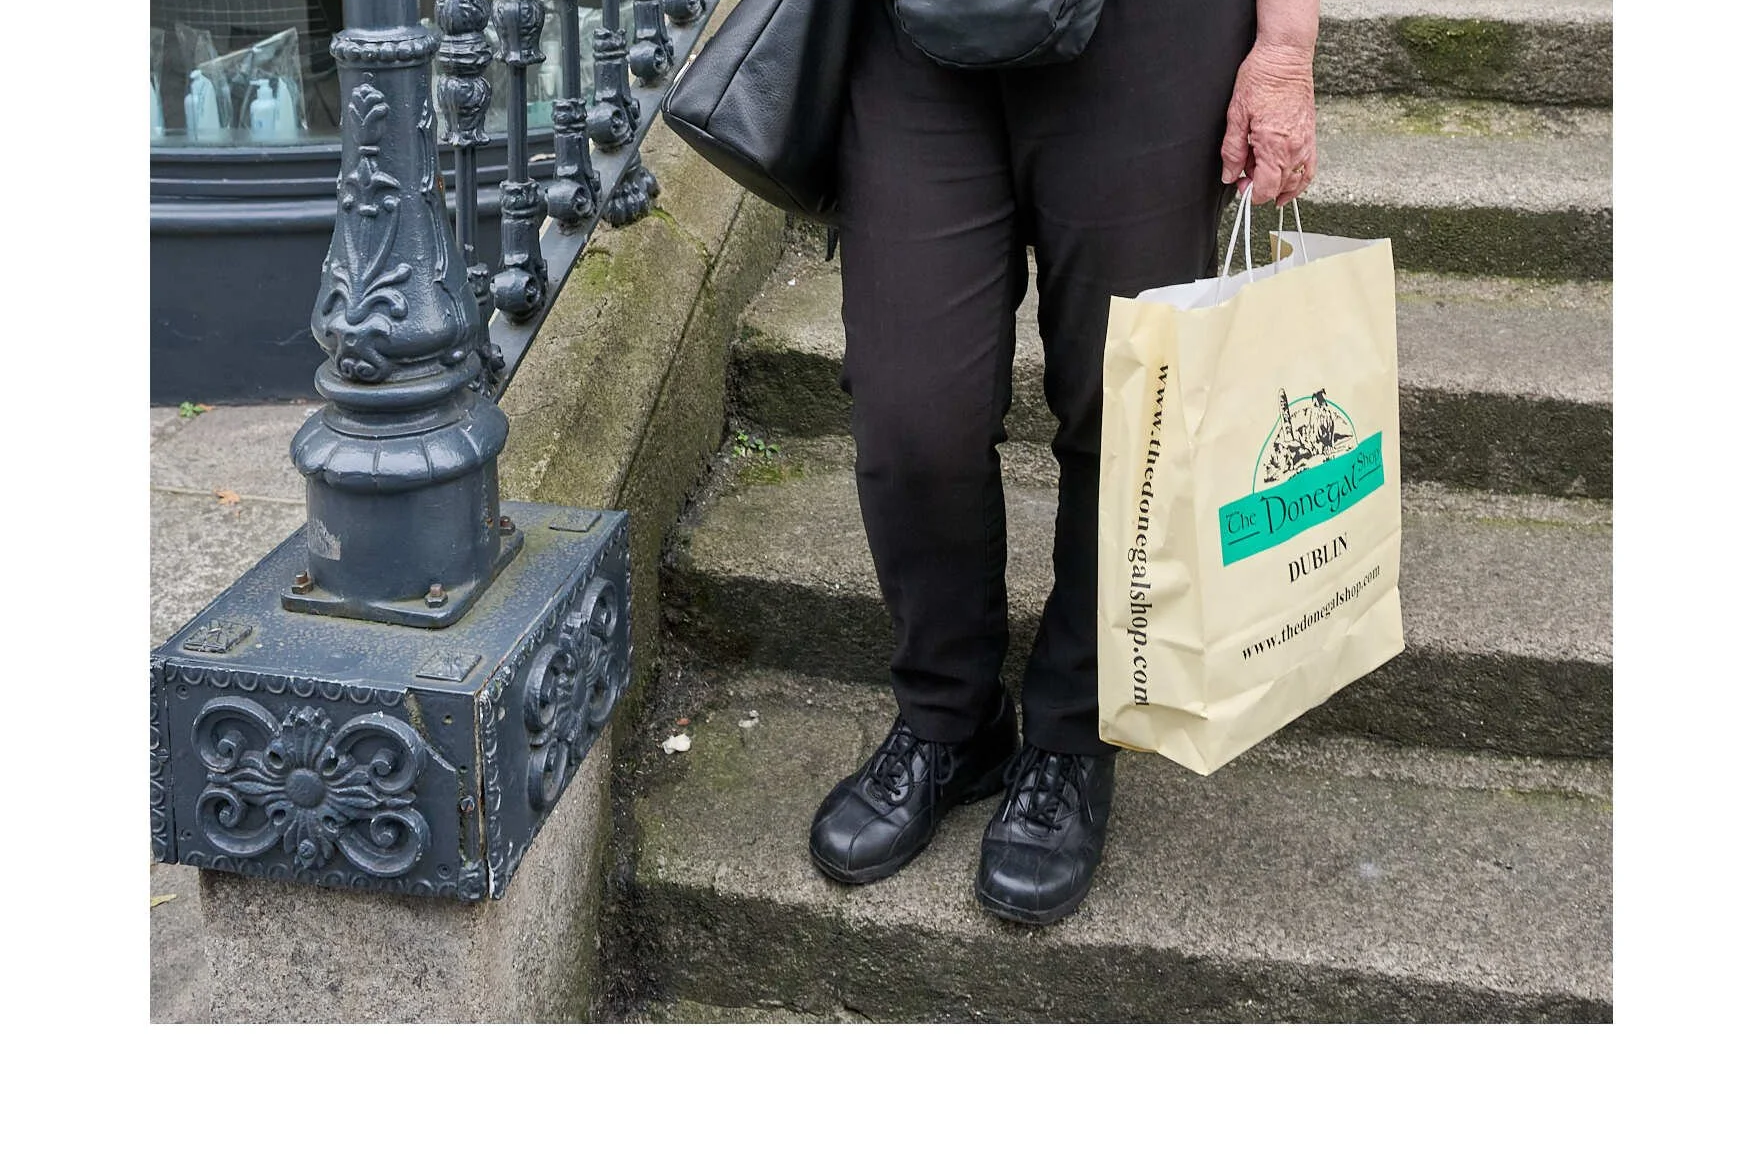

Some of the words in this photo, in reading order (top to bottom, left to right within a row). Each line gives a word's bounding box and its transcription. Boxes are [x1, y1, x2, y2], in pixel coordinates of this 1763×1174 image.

[1127, 364, 1168, 706] www.thedonegalshop.com
[1225, 511, 1256, 534] The
[1260, 464, 1357, 534] Donegal
[1357, 448, 1380, 467] Shop
[1288, 531, 1348, 583] DUBLIN
[1242, 565, 1380, 661] www.thedonegalshop.com
